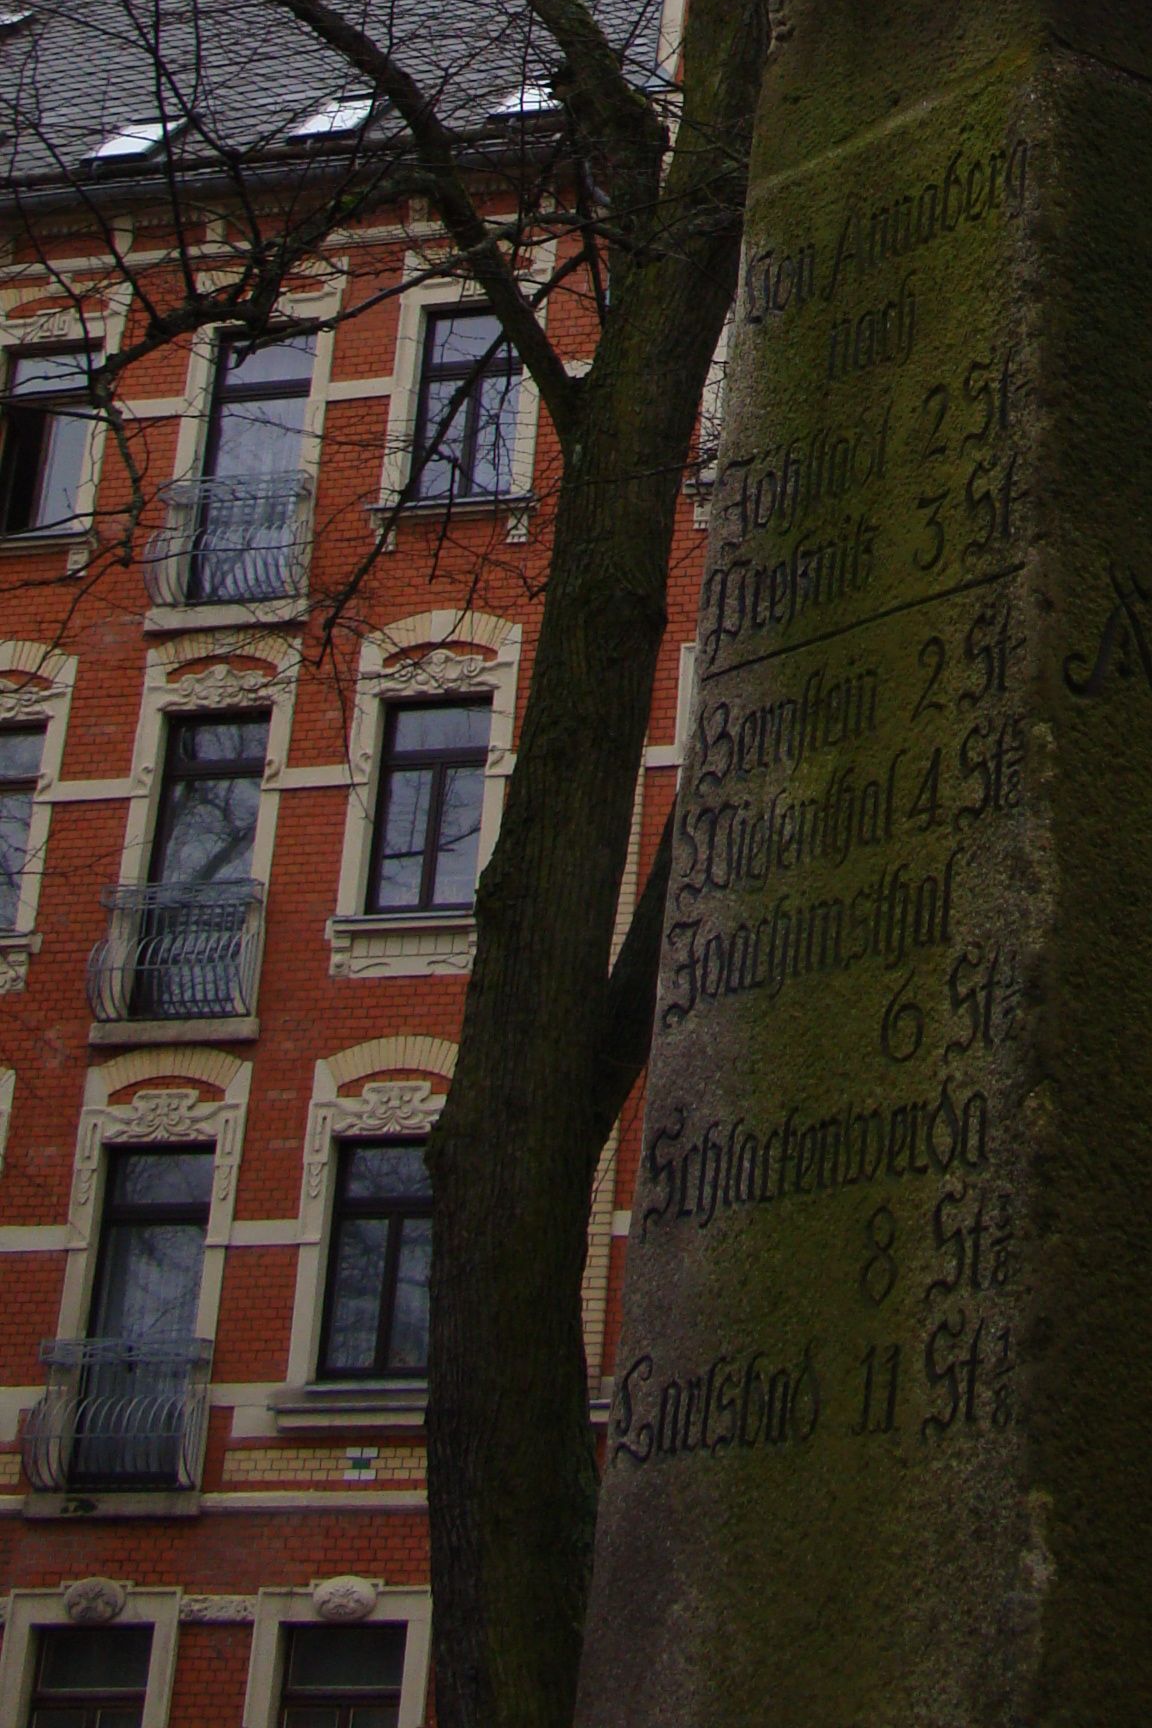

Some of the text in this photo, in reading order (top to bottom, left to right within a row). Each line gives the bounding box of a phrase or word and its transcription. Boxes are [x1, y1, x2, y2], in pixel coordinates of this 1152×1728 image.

[742, 138, 1036, 325] Von Annaberg
[828, 270, 916, 384] nach
[922, 383, 948, 459] 2
[914, 487, 950, 571] 3
[911, 635, 946, 723] 2
[908, 746, 943, 833] 4
[879, 966, 924, 1064] 6
[859, 1202, 899, 1308] 8
[850, 1342, 903, 1437] 11
